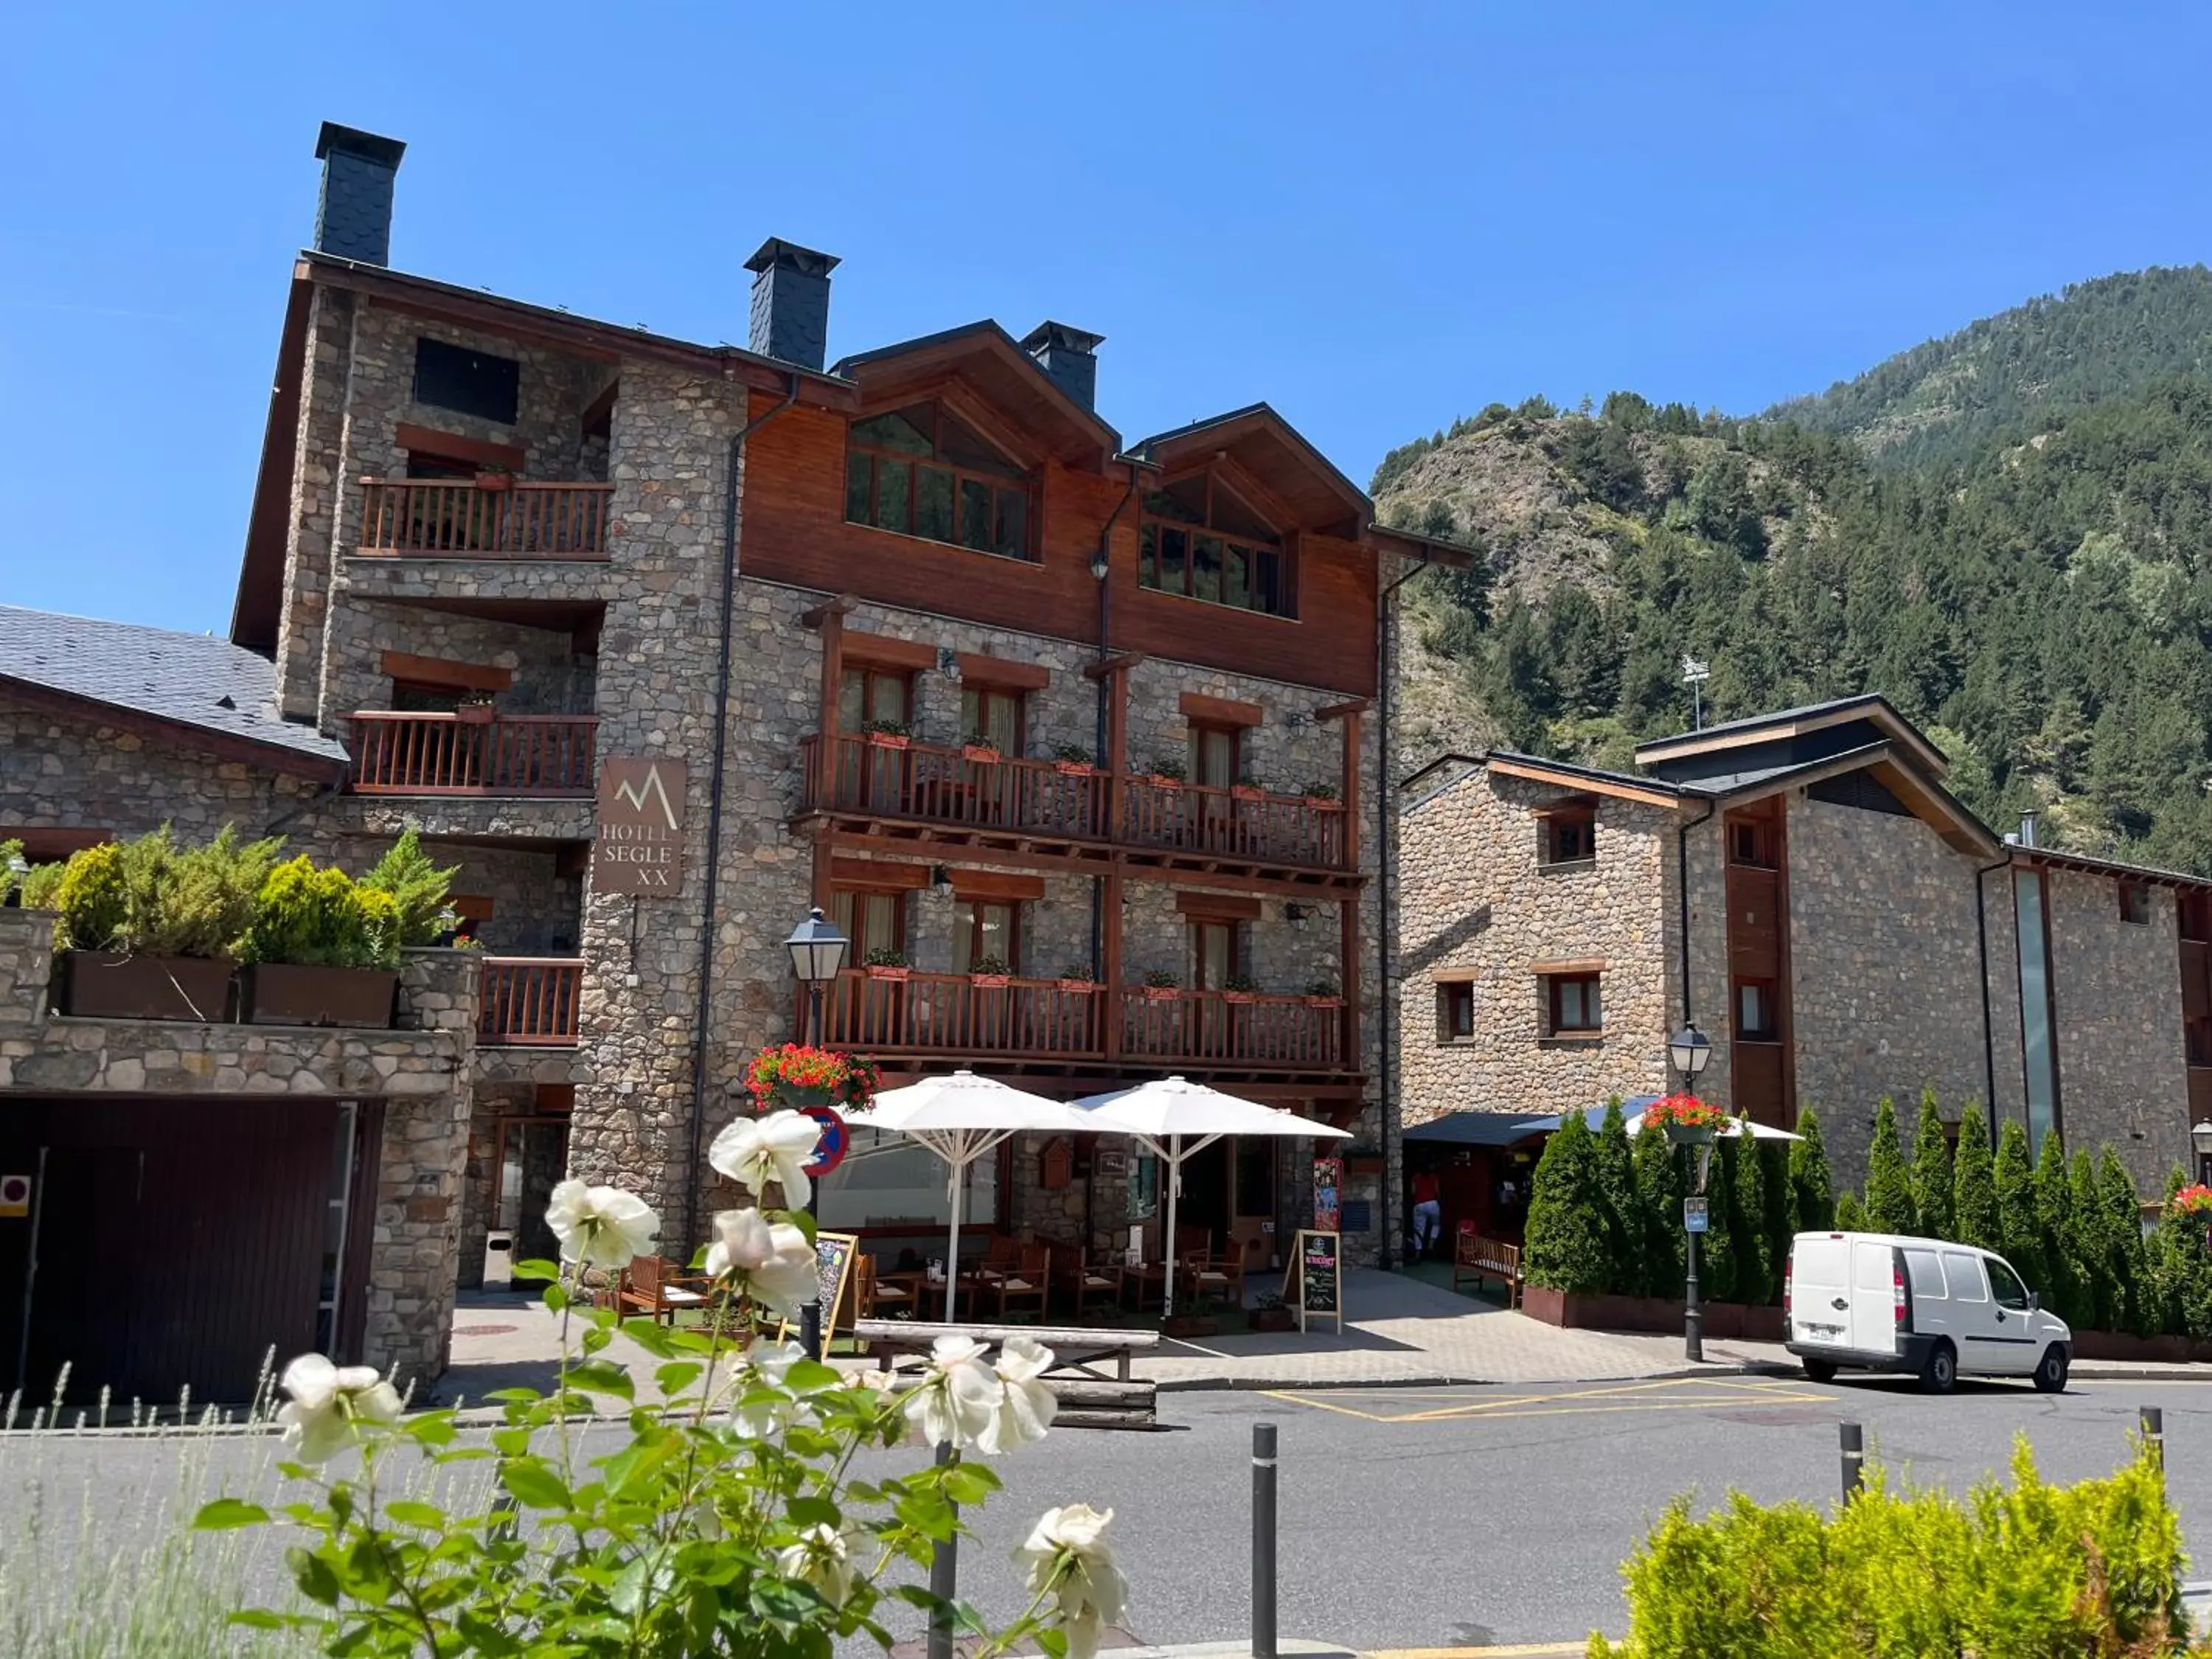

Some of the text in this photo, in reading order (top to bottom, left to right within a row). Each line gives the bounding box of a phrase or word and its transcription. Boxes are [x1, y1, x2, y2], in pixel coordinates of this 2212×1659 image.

[603, 824, 672, 841] HOTEL
[605, 846, 672, 863] SEGLE
[637, 869, 669, 886] XX
